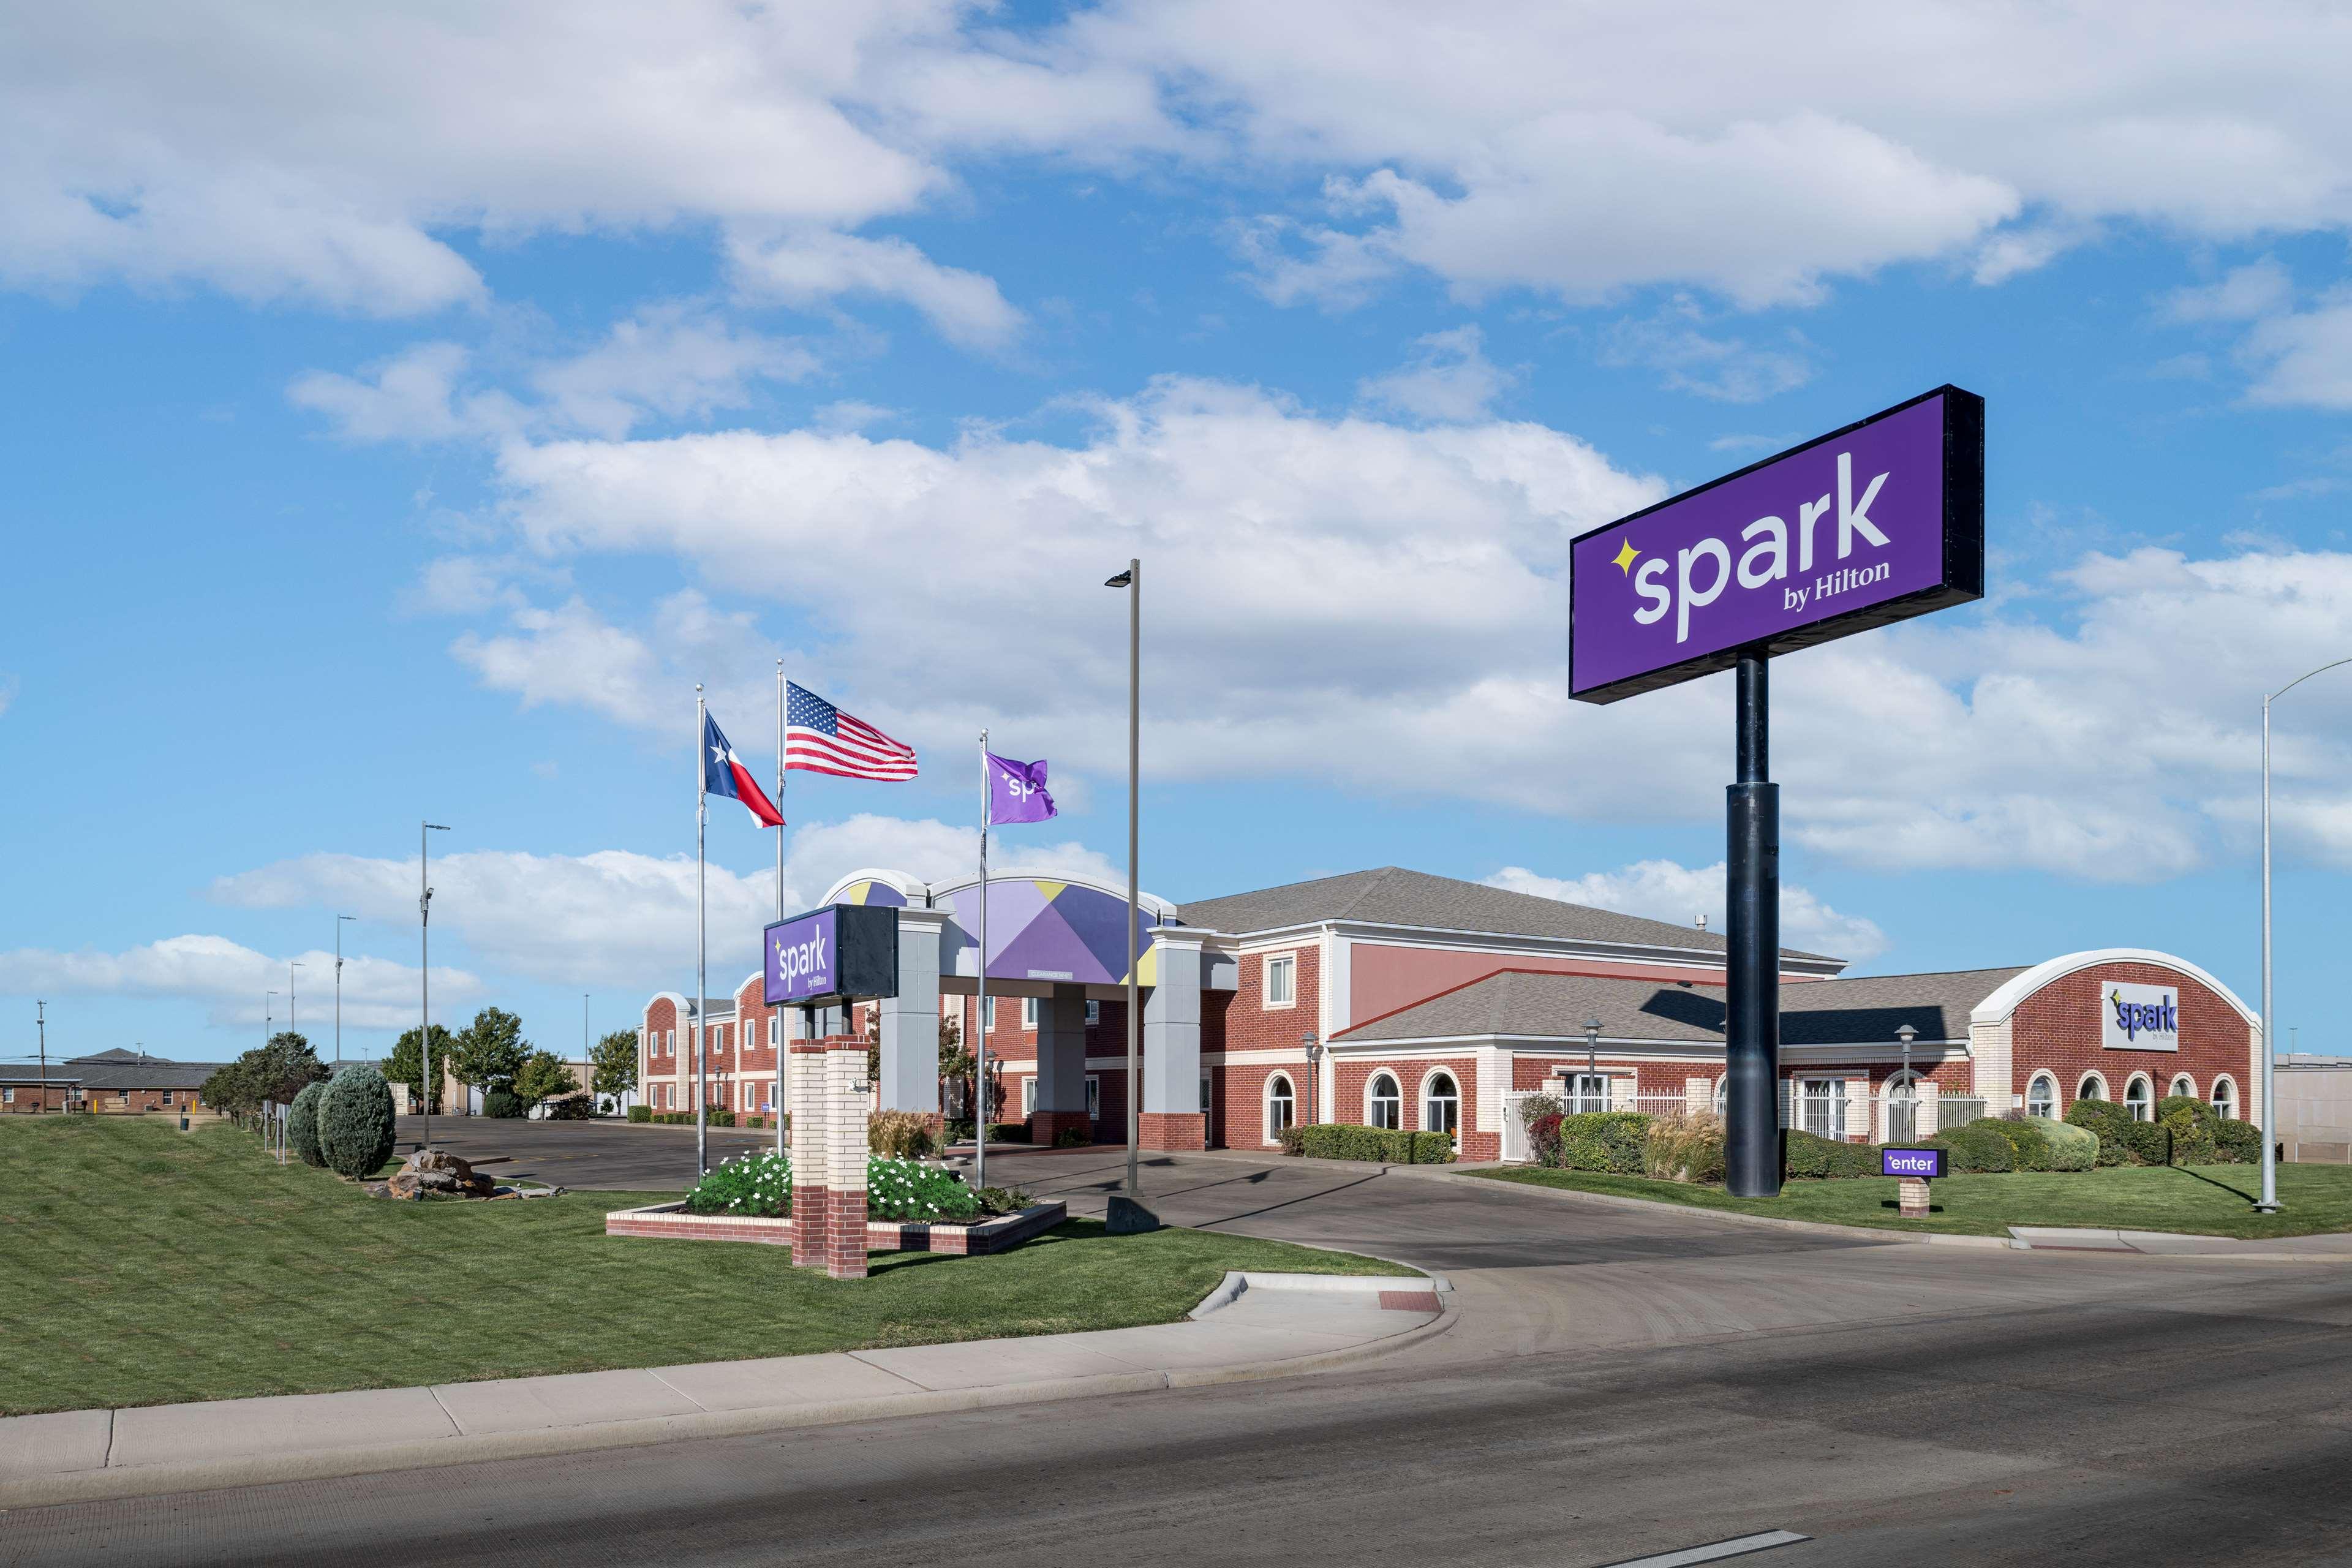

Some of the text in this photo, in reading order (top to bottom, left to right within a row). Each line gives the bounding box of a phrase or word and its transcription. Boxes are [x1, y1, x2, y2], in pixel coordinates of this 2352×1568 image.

[1633, 452, 1891, 644] spark
[1784, 562, 1890, 612] by Hilton
[779, 924, 826, 993] spark
[808, 975, 826, 990] by Hilton
[2117, 994, 2177, 1041] spark
[2152, 1031, 2174, 1042] by Hilton
[1891, 1156, 1934, 1170] enter
